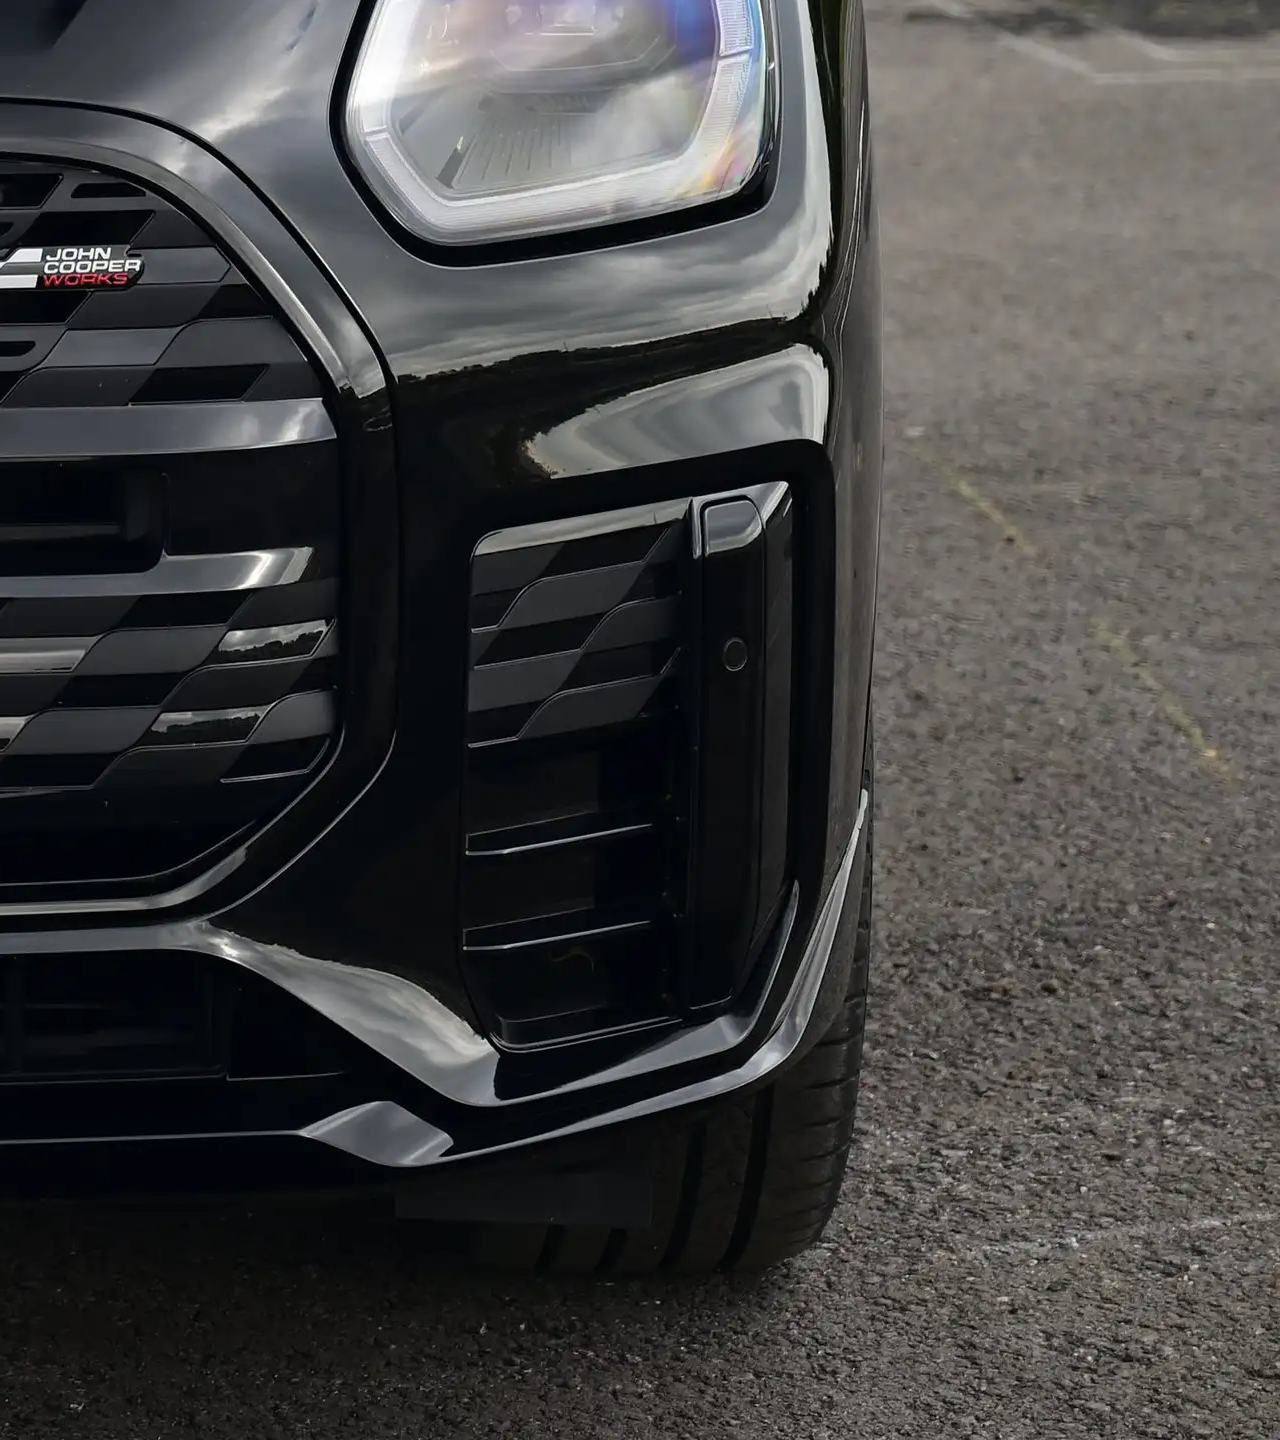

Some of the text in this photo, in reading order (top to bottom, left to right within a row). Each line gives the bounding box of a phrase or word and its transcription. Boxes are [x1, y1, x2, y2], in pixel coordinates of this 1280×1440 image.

[46, 247, 111, 261] JOHN
[43, 259, 141, 275] COOPER
[43, 272, 129, 288] WORKS
